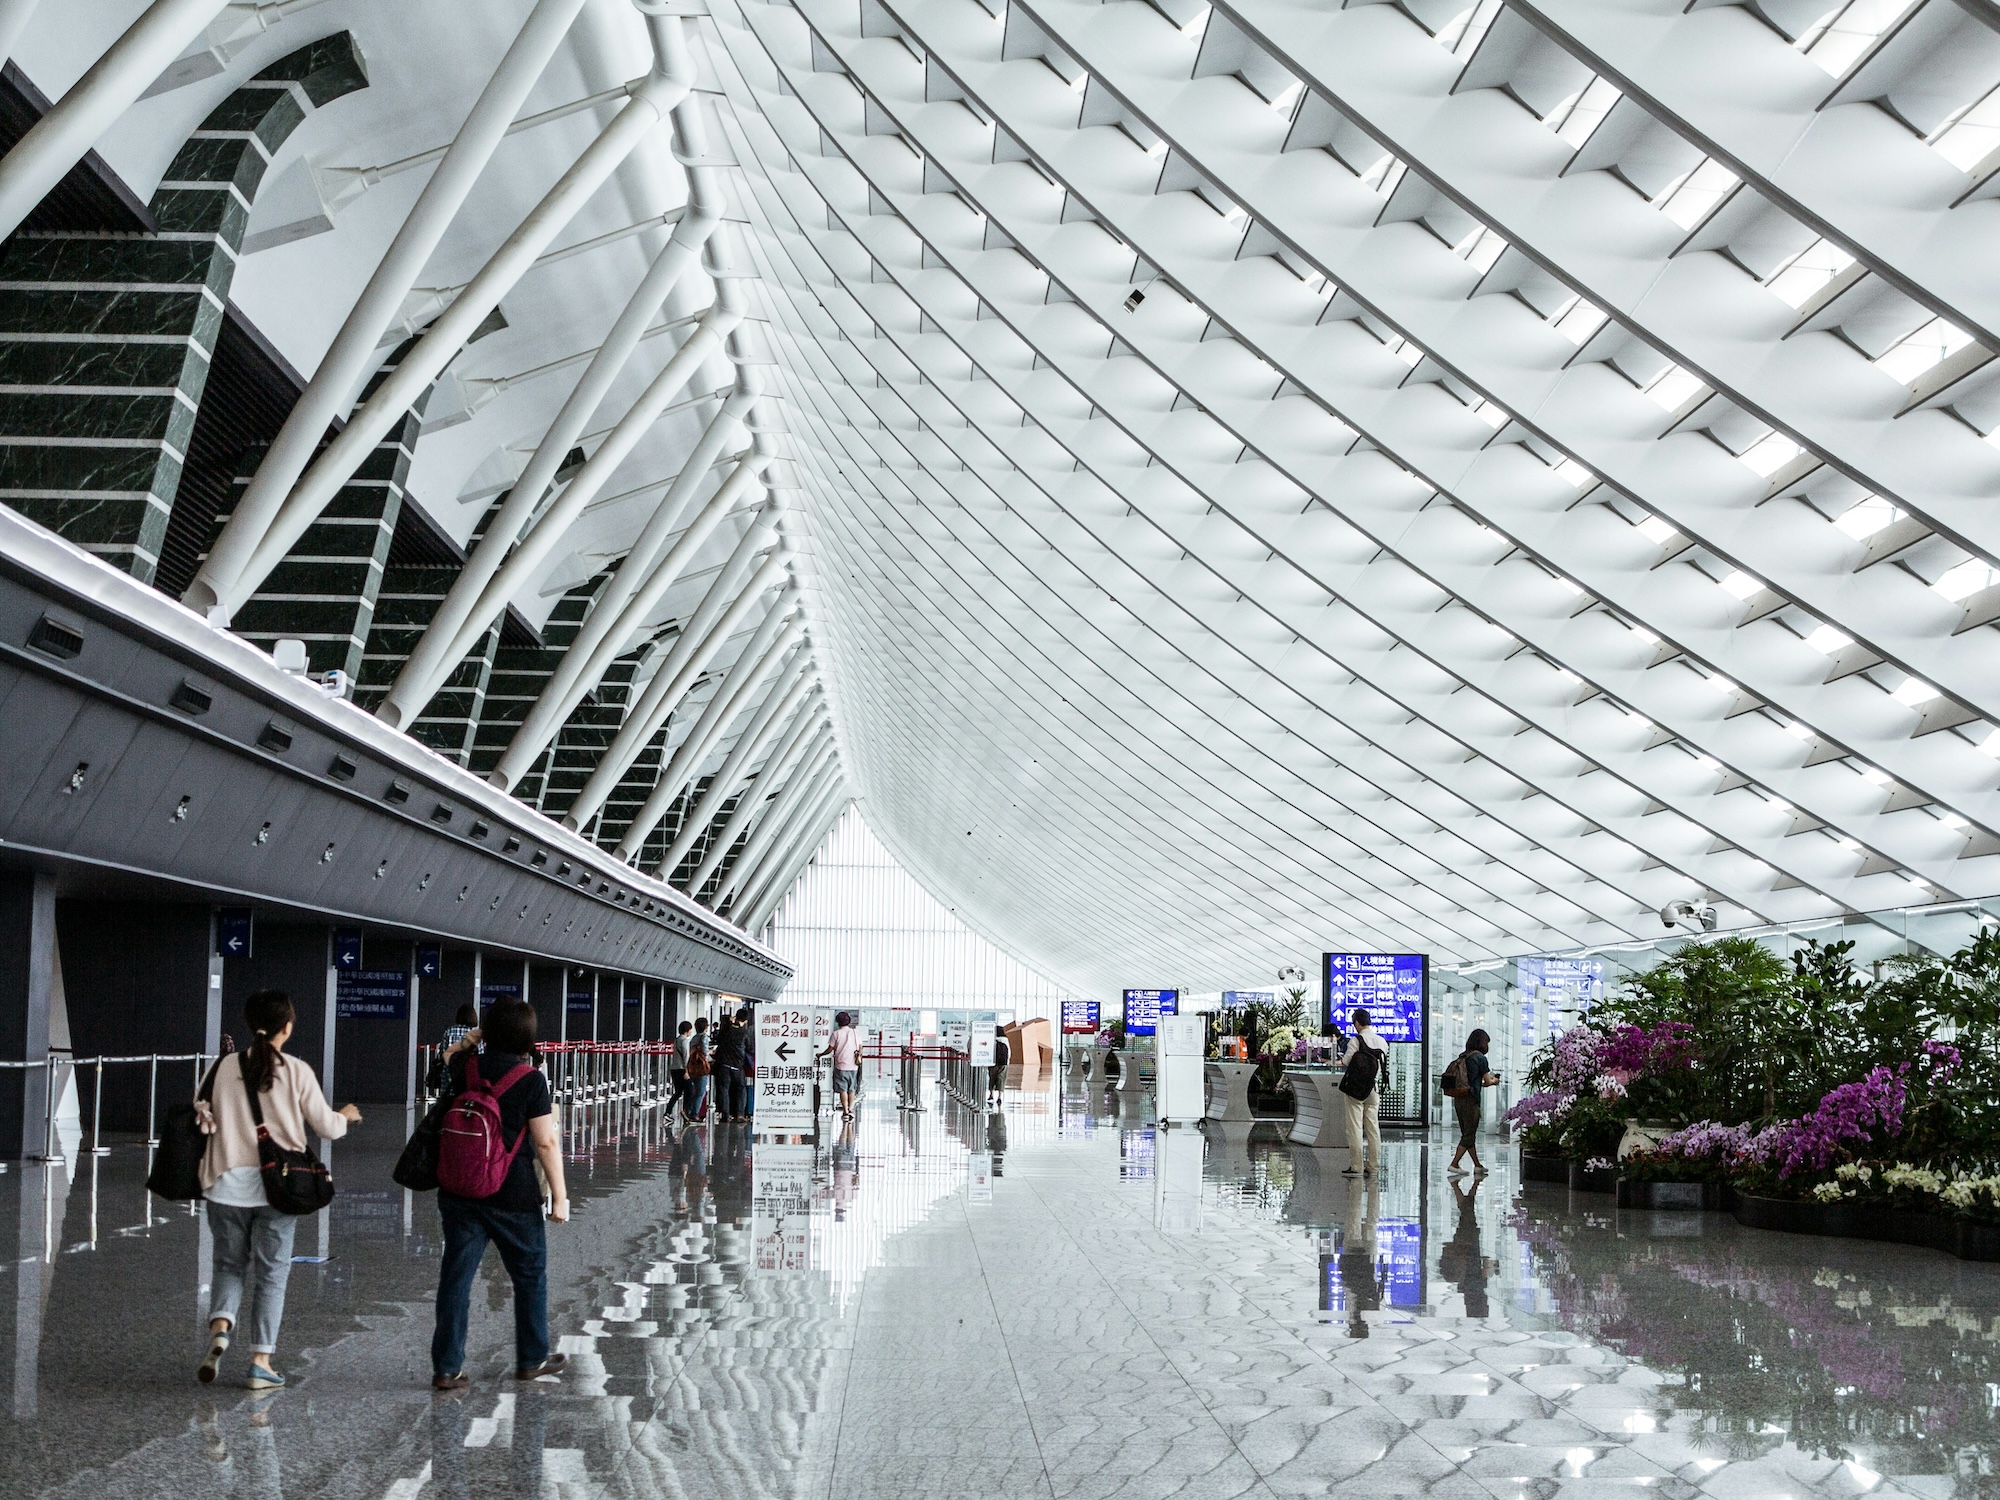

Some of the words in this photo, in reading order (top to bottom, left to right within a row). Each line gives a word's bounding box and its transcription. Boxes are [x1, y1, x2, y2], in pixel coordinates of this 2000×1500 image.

[762, 1011, 809, 1025] 通關12秒
[762, 1024, 809, 1038] 申辦2分鐘
[756, 1066, 813, 1080] 自動通關
[762, 1083, 805, 1097] 及申辦
